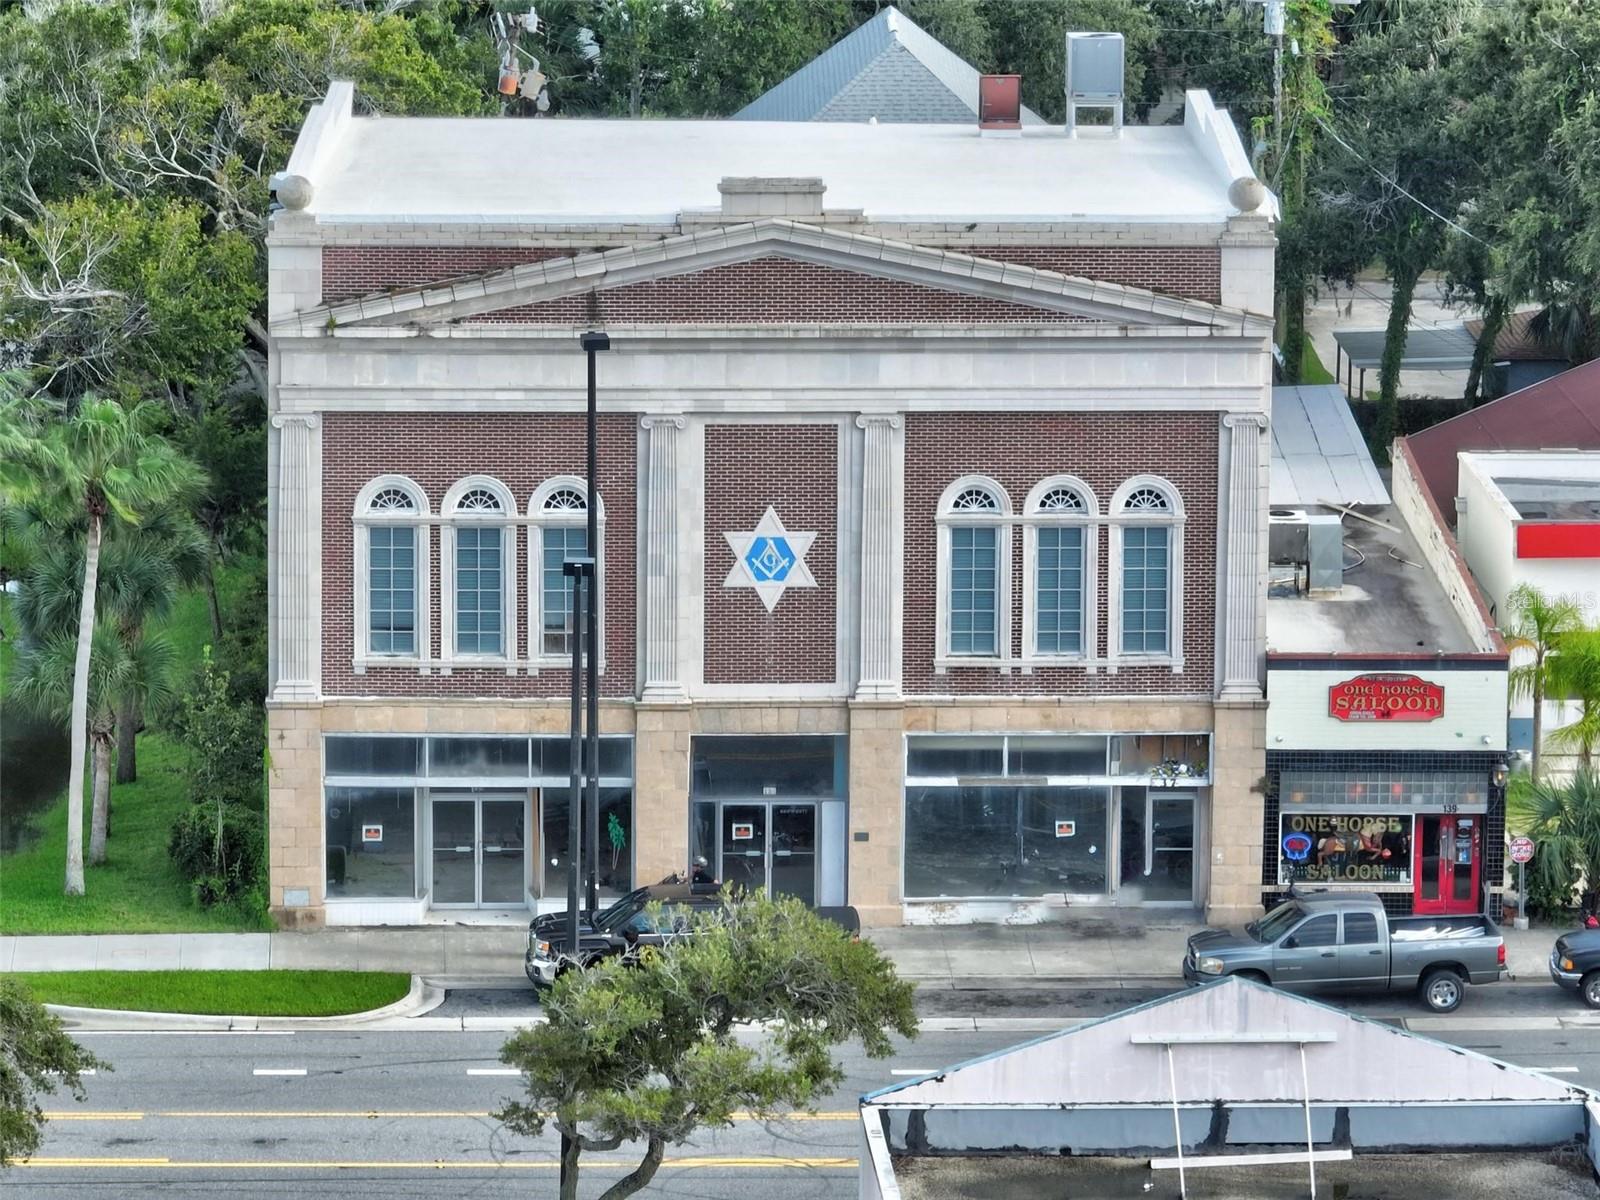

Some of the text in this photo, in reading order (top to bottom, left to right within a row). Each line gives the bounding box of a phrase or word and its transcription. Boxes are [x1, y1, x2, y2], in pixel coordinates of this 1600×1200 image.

[1335, 696, 1440, 711] SALOON
[1443, 804, 1457, 813] 139
[1292, 816, 1399, 832] ONE HORSE
[1307, 864, 1385, 880] SALOON
